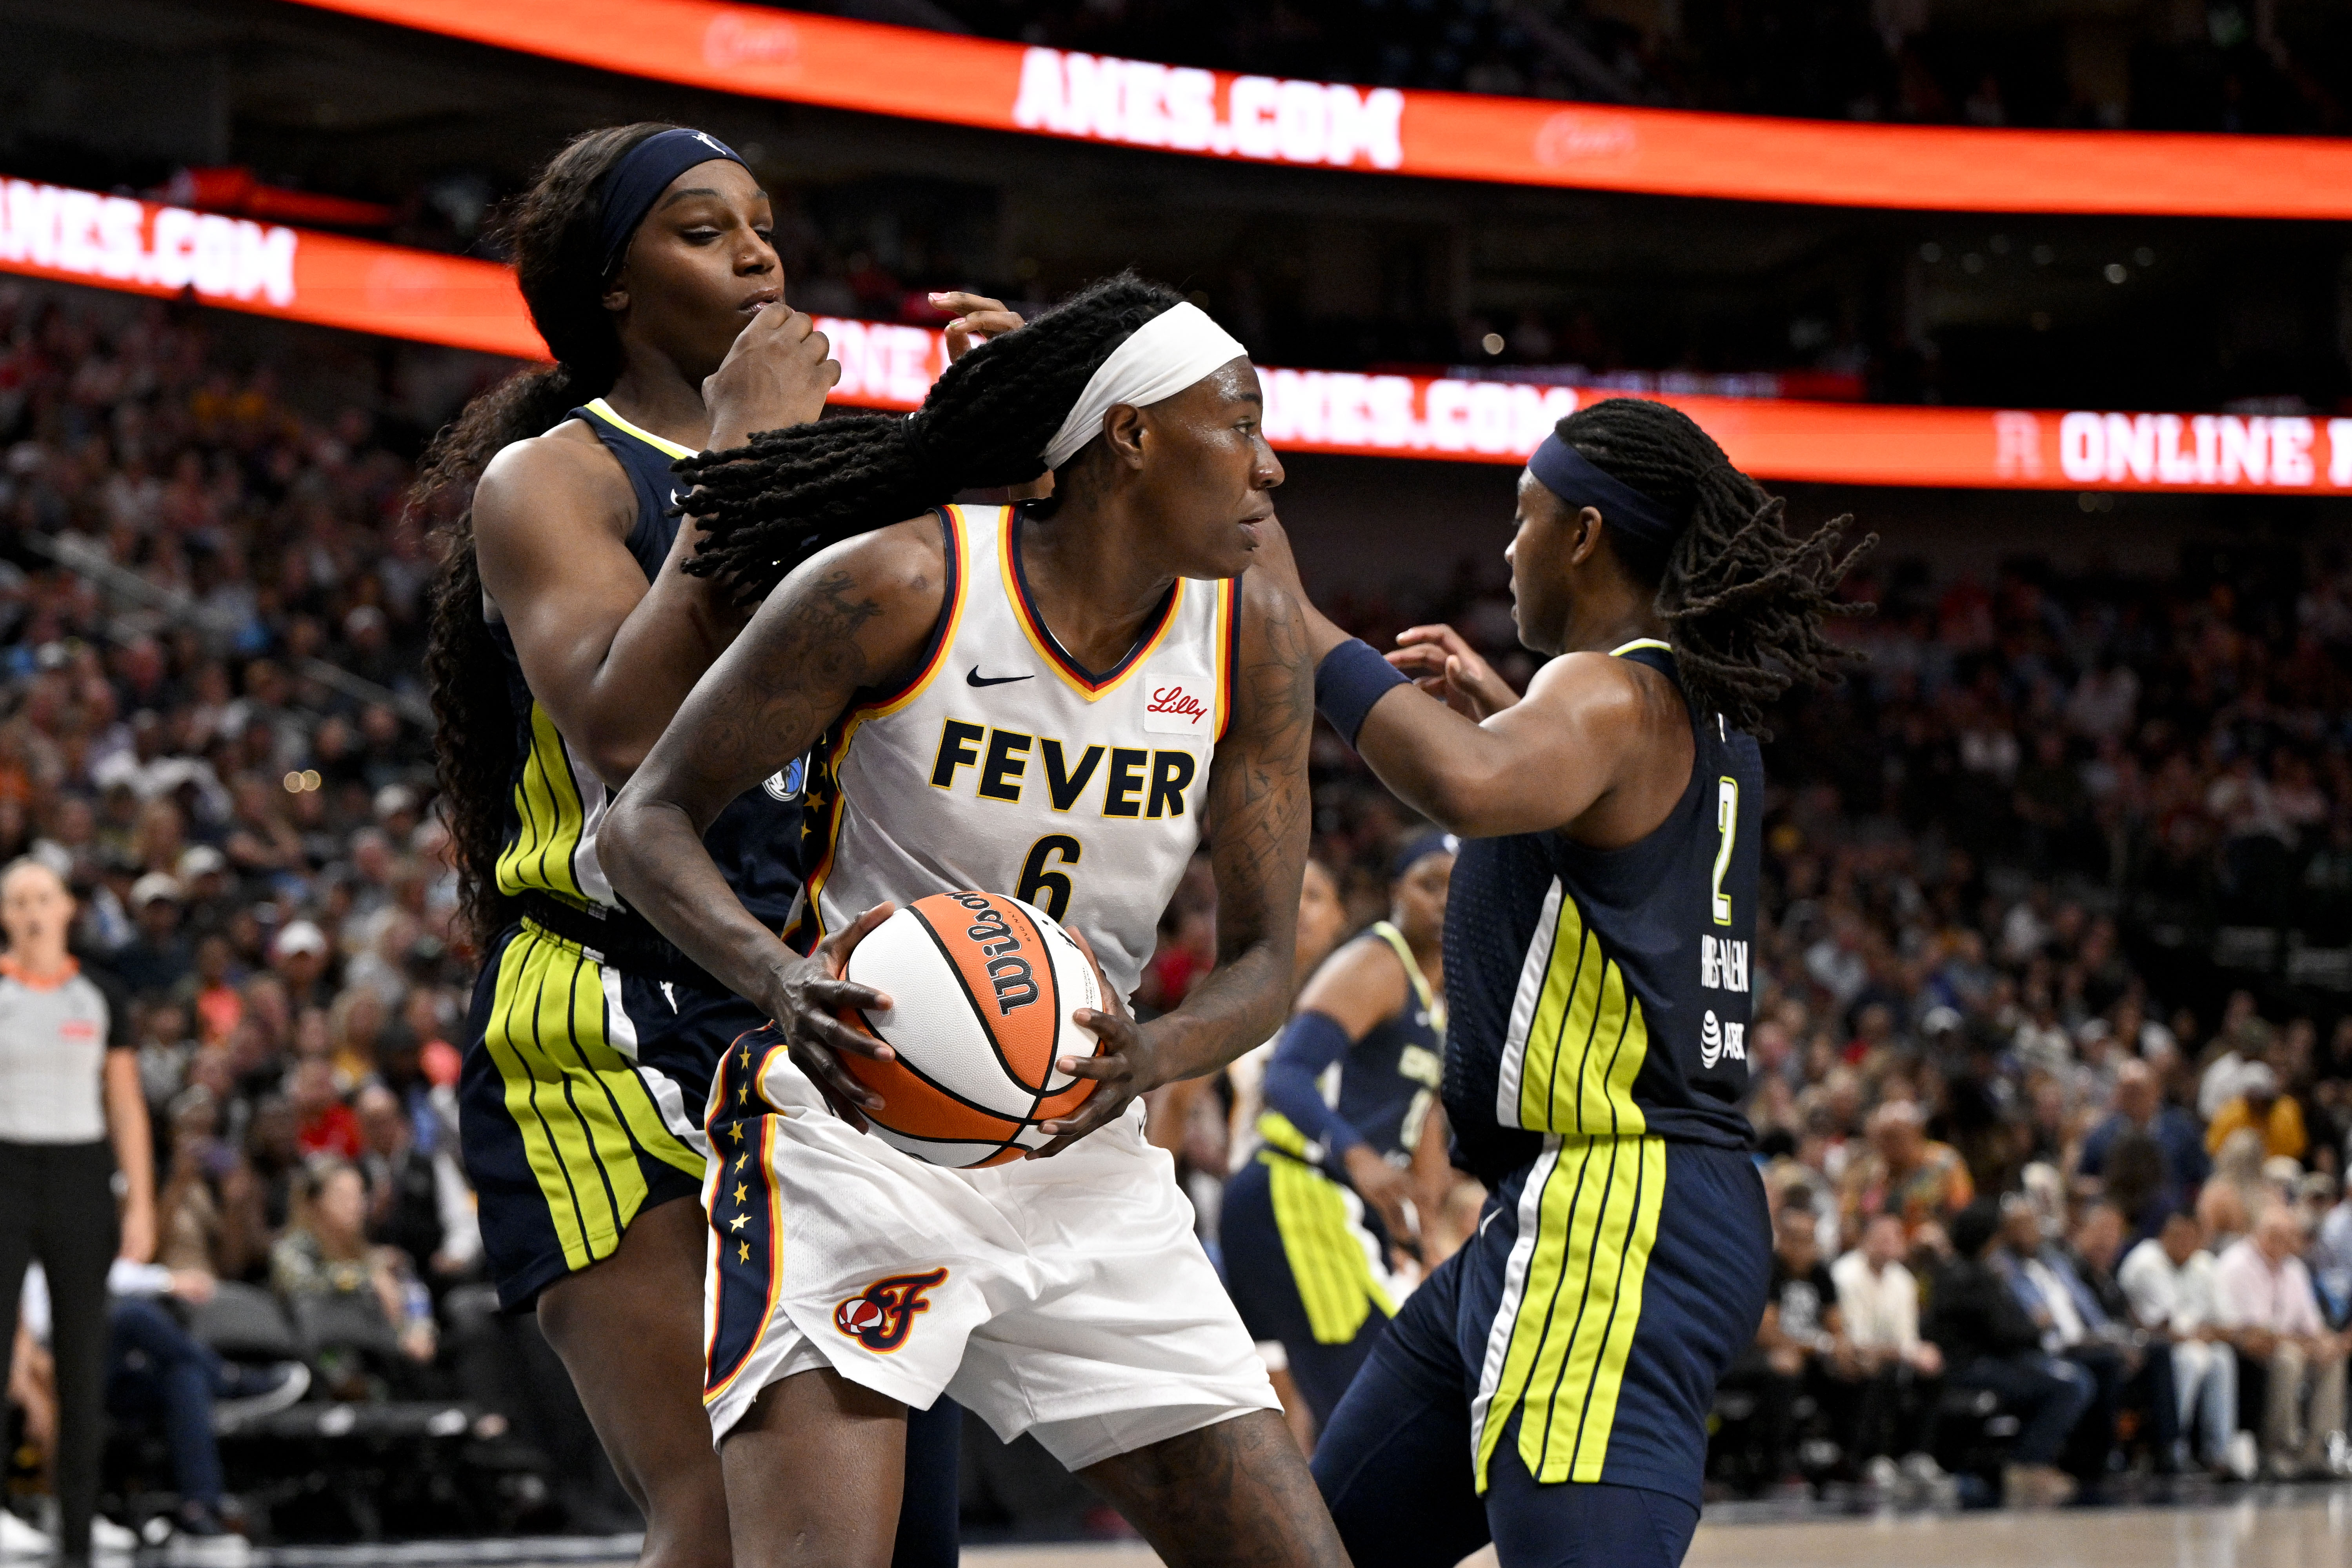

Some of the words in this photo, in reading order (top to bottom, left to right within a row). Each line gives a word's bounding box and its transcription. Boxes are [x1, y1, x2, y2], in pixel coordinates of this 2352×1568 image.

[2060, 411, 2315, 486] ONLINE
[1147, 686, 1208, 724] Lilly
[928, 716, 1197, 820] FEVER
[1013, 833, 1083, 924] 6
[1712, 775, 1738, 926] 2
[943, 891, 1040, 1017] Wilson
